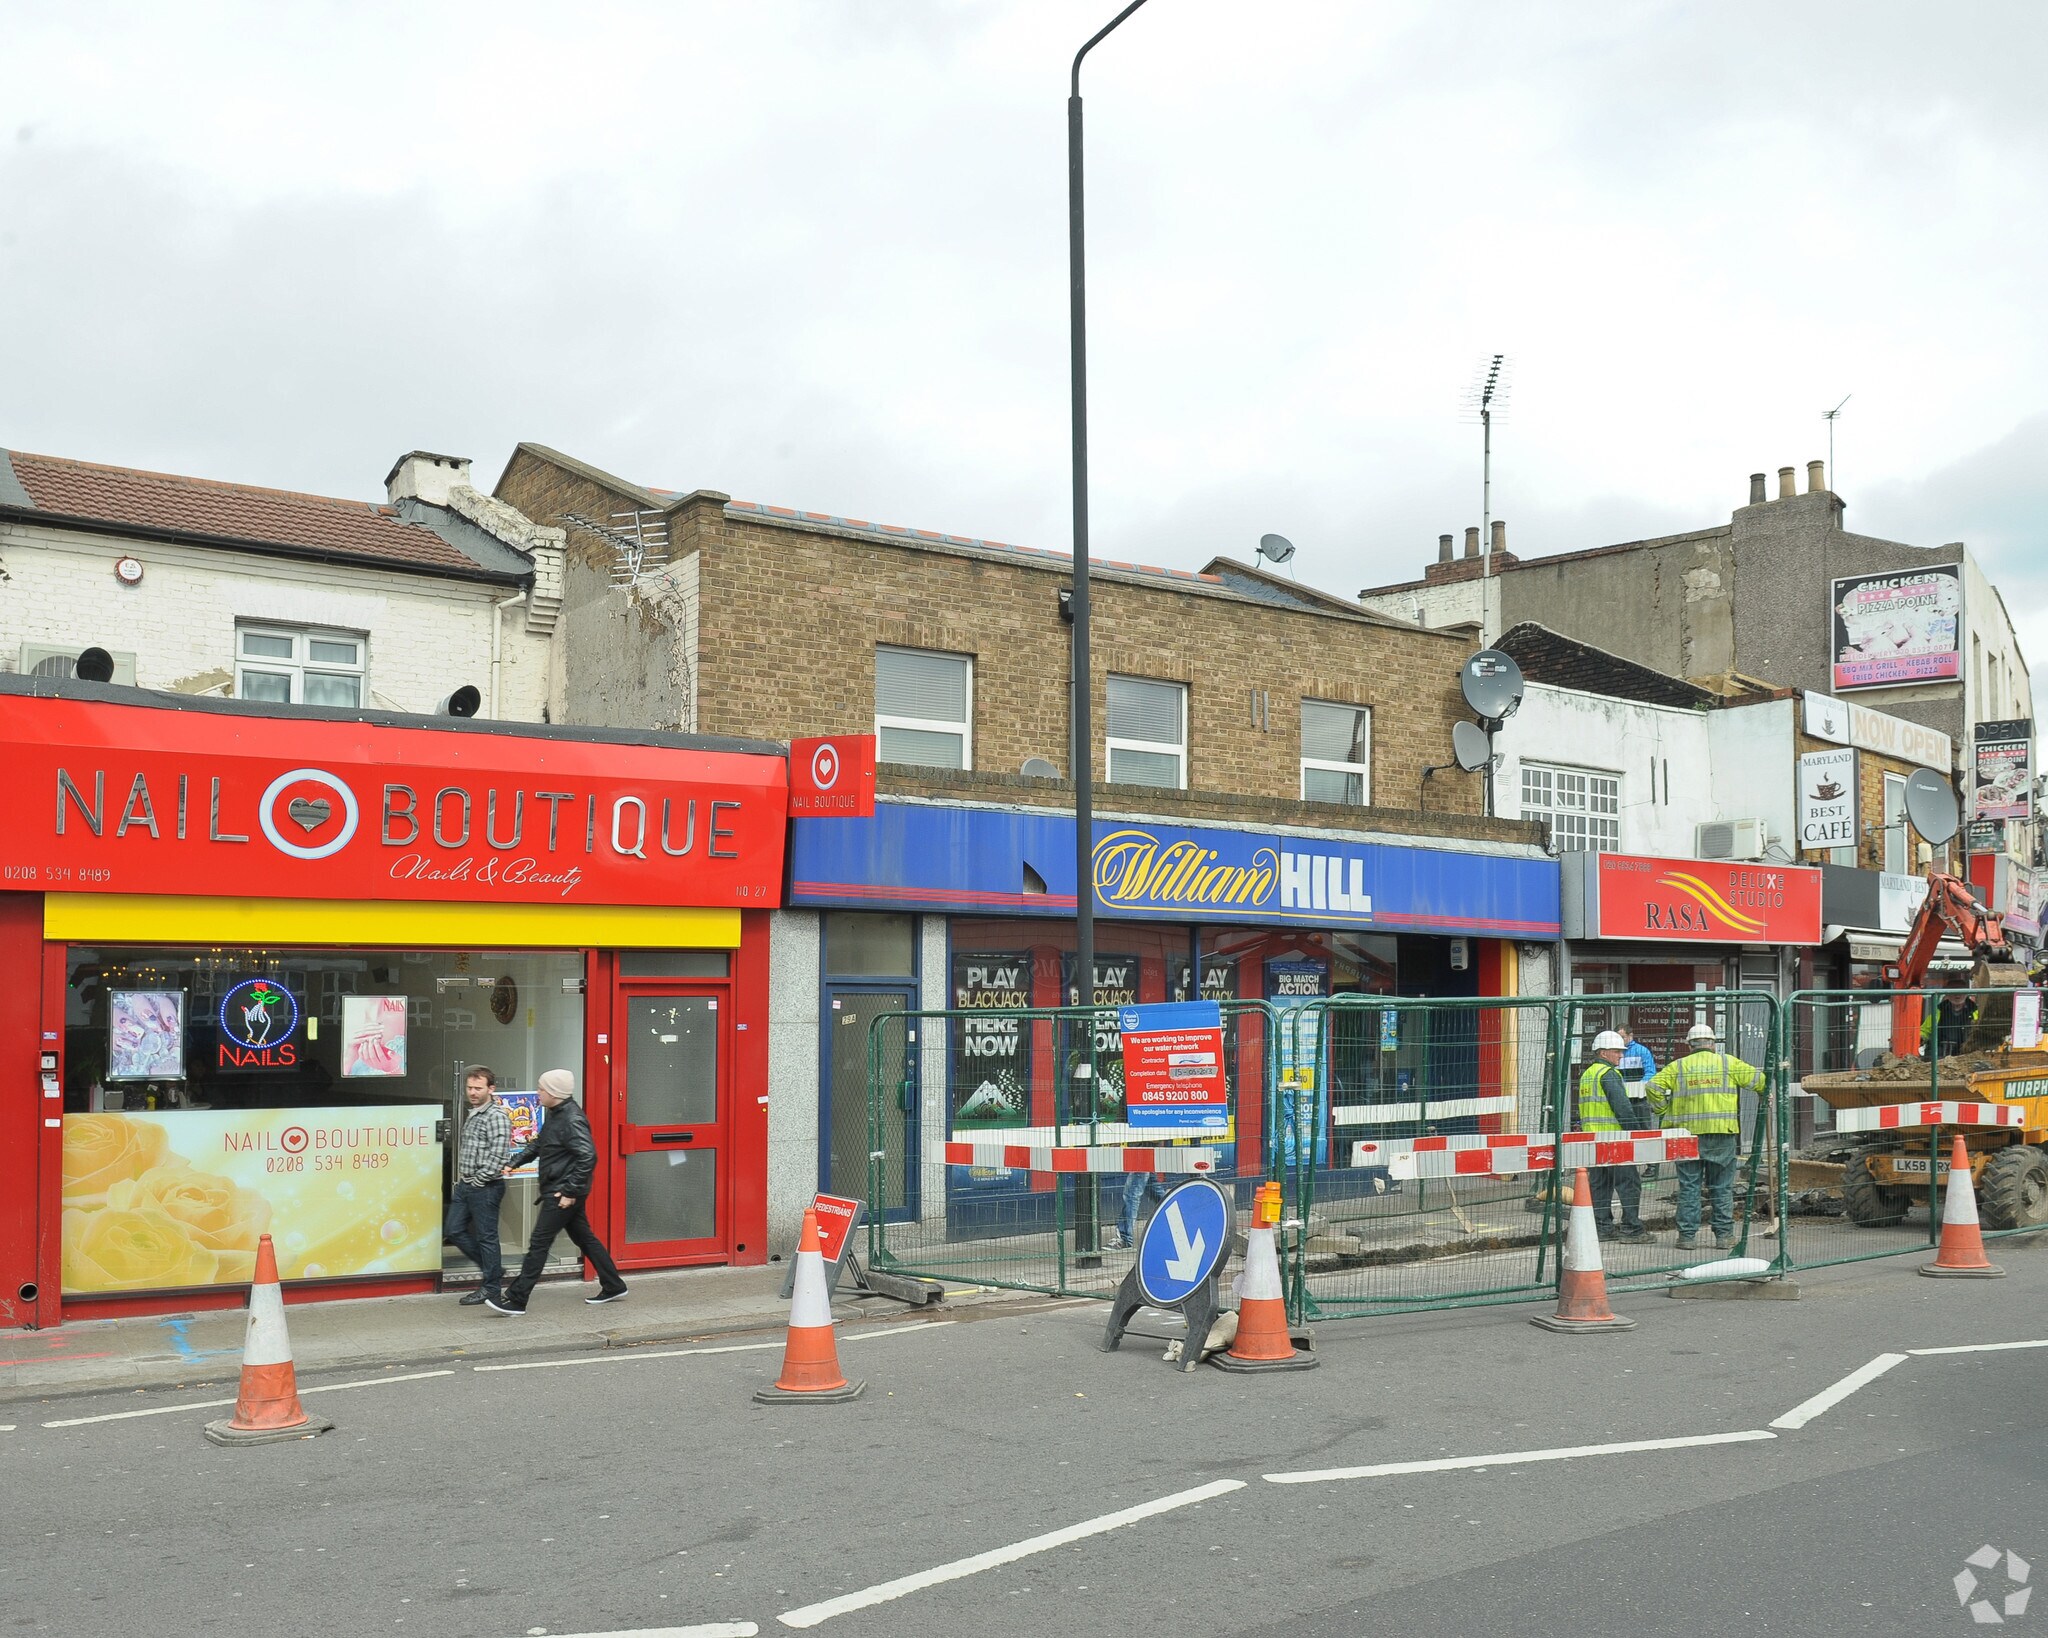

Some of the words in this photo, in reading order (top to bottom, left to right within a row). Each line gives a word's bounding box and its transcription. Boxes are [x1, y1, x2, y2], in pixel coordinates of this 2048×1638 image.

[1857, 573, 1938, 592] CHICKEN
[1858, 600, 1894, 614] PIZZA
[1898, 594, 1938, 609] POINT
[1860, 664, 1873, 672] MIX
[1876, 662, 1898, 670] GRILL
[1906, 659, 1931, 668] KEBAB
[1934, 656, 1952, 664] ROLL
[1852, 673, 1873, 682] FRIED
[1876, 669, 1908, 679] CHICKEN
[1916, 666, 1938, 675] PIZZA
[1854, 709, 1896, 749] NOW
[1901, 725, 1947, 766] OPEN!
[1975, 721, 2026, 740] OPEN
[1978, 743, 2027, 753] CHICKEN
[1803, 753, 1851, 767] MARYLAND
[793, 797, 810, 808] NAIL
[814, 795, 855, 808] BOUTIQUE
[56, 768, 249, 842] NAIL
[382, 783, 742, 859] BOUTIQUE
[1810, 805, 1845, 818] BEST
[1804, 816, 1852, 842] CAFÉ
[4, 866, 37, 880] 0208
[46, 867, 71, 881] 534
[78, 868, 111, 882] 8489
[390, 854, 468, 883] Nails
[475, 857, 497, 887] &
[502, 858, 584, 896] Beauty
[1092, 829, 1280, 910] William
[1281, 851, 1372, 913] HILL
[755, 887, 766, 897] 27
[1729, 890, 1784, 908] STUDIO
[1645, 903, 1709, 931] RASA
[967, 967, 1018, 988] PLAY
[1092, 967, 1127, 988] LAY
[1278, 974, 1293, 983] BIG
[1293, 974, 1320, 984] MATCH
[1070, 989, 1135, 1006] BCKJACK
[1277, 983, 1319, 995] ACTION
[383, 999, 405, 1013] NAILS
[958, 990, 1028, 1008] BLACKJACK
[965, 1017, 1018, 1033] HERE
[1094, 1010, 1121, 1030] ER
[965, 1035, 1018, 1057] NOW
[1095, 1032, 1123, 1053] OW
[1152, 1035, 1177, 1044] working
[1185, 1034, 1212, 1043] improve
[1155, 1044, 1172, 1052] water
[1173, 1043, 1199, 1051] network
[219, 1044, 296, 1067] NAILS
[1130, 1070, 1155, 1078] Completion
[1146, 1082, 1175, 1090] Emergency
[1176, 1081, 1202, 1089] telephone
[2006, 1080, 2048, 1098] MURPH
[1142, 1091, 1165, 1101] 0845
[1166, 1091, 1189, 1100] 9200
[1190, 1090, 1208, 1100] 800
[1142, 1108, 1166, 1116] apologise
[224, 1132, 278, 1151] NAIL
[315, 1127, 429, 1149] BOUTIQUE
[266, 1158, 304, 1173] 0208
[315, 1156, 343, 1171] 534
[352, 1153, 389, 1169] 8489
[1897, 1160, 1927, 1171] LK58
[815, 1202, 852, 1218] PEDESTRIANS
